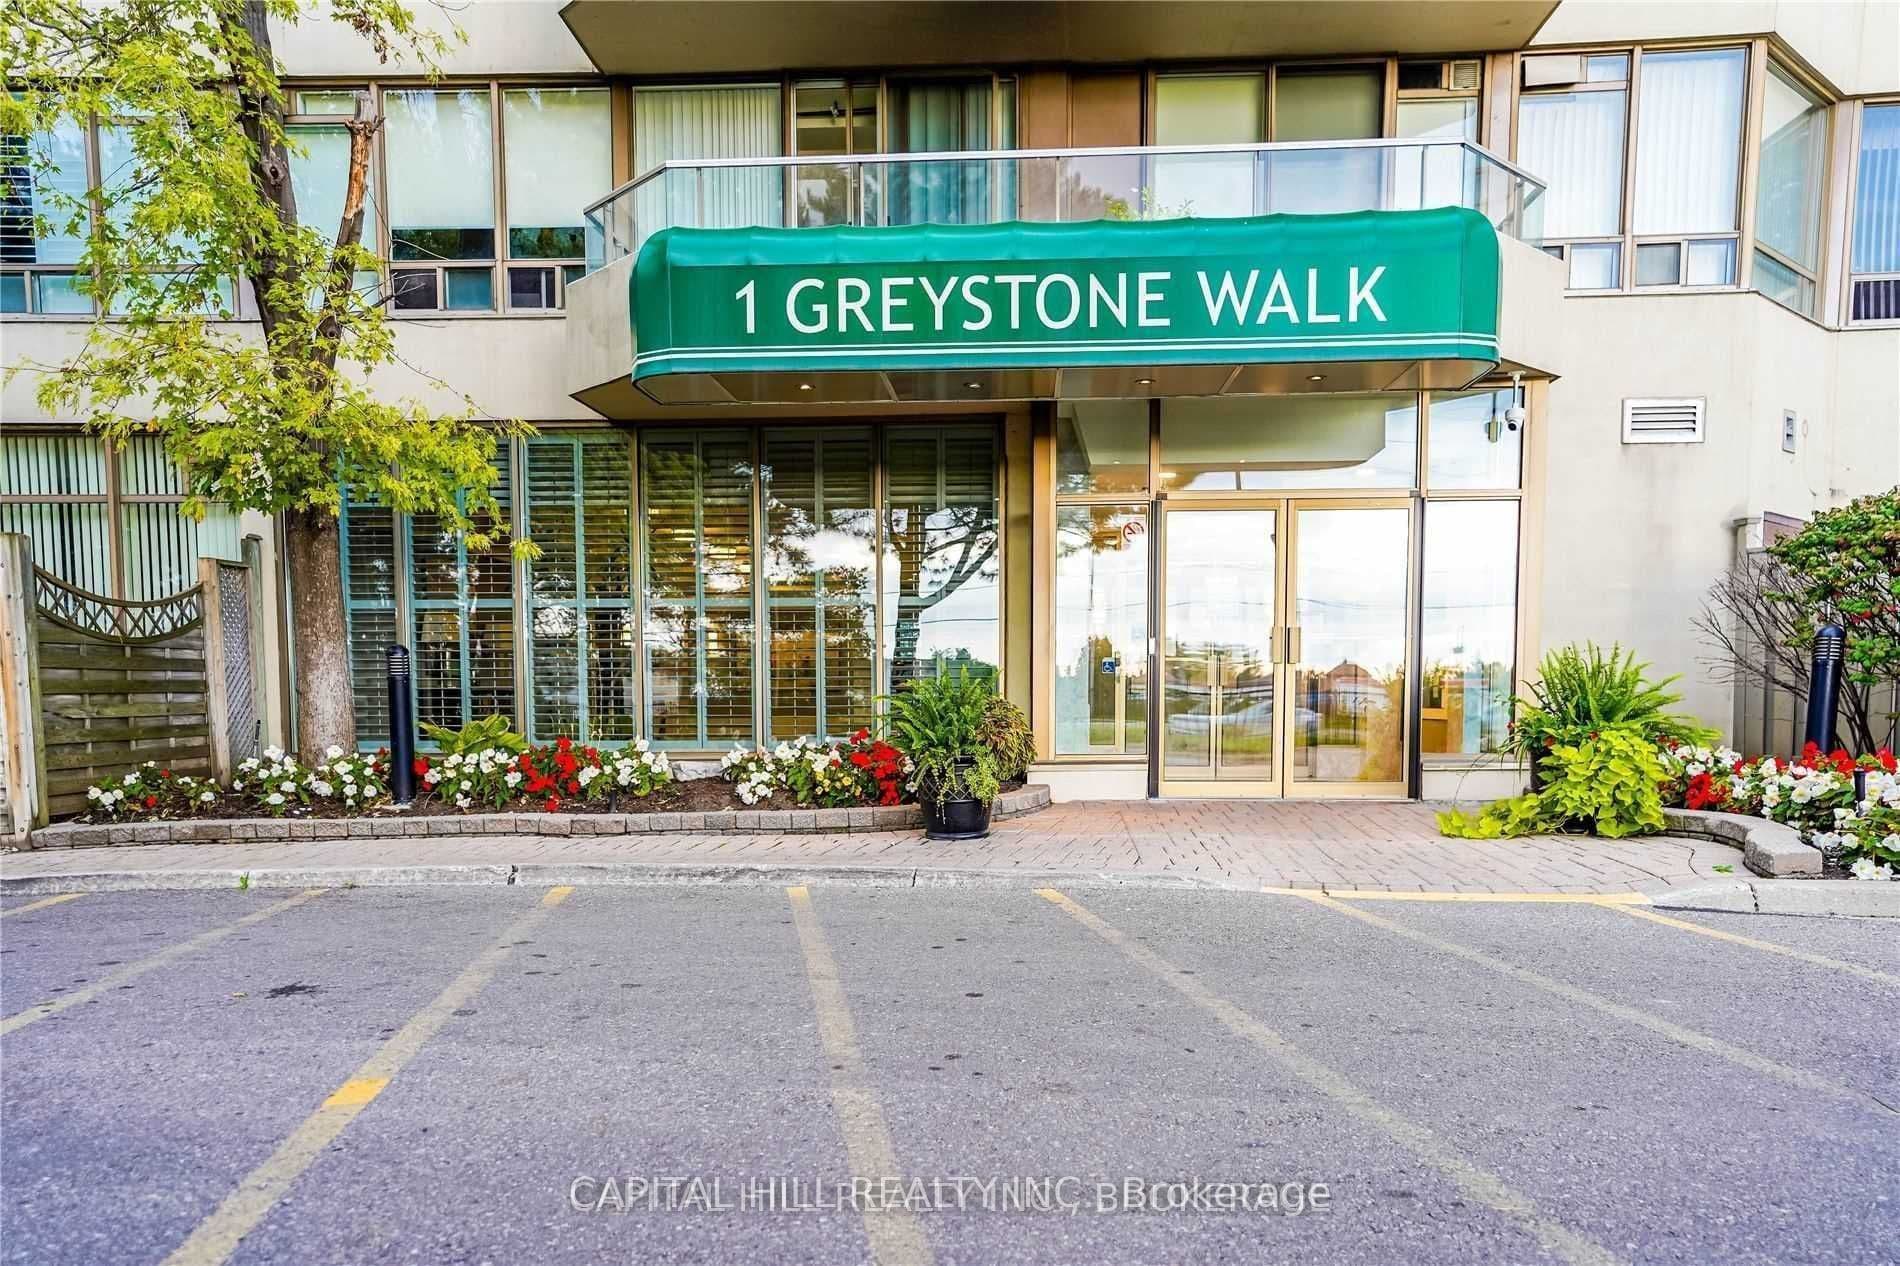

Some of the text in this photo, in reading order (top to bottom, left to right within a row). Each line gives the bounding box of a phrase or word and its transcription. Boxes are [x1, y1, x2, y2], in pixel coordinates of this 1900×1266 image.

[735, 267, 1387, 334] 1 GREYSTONE WALK
